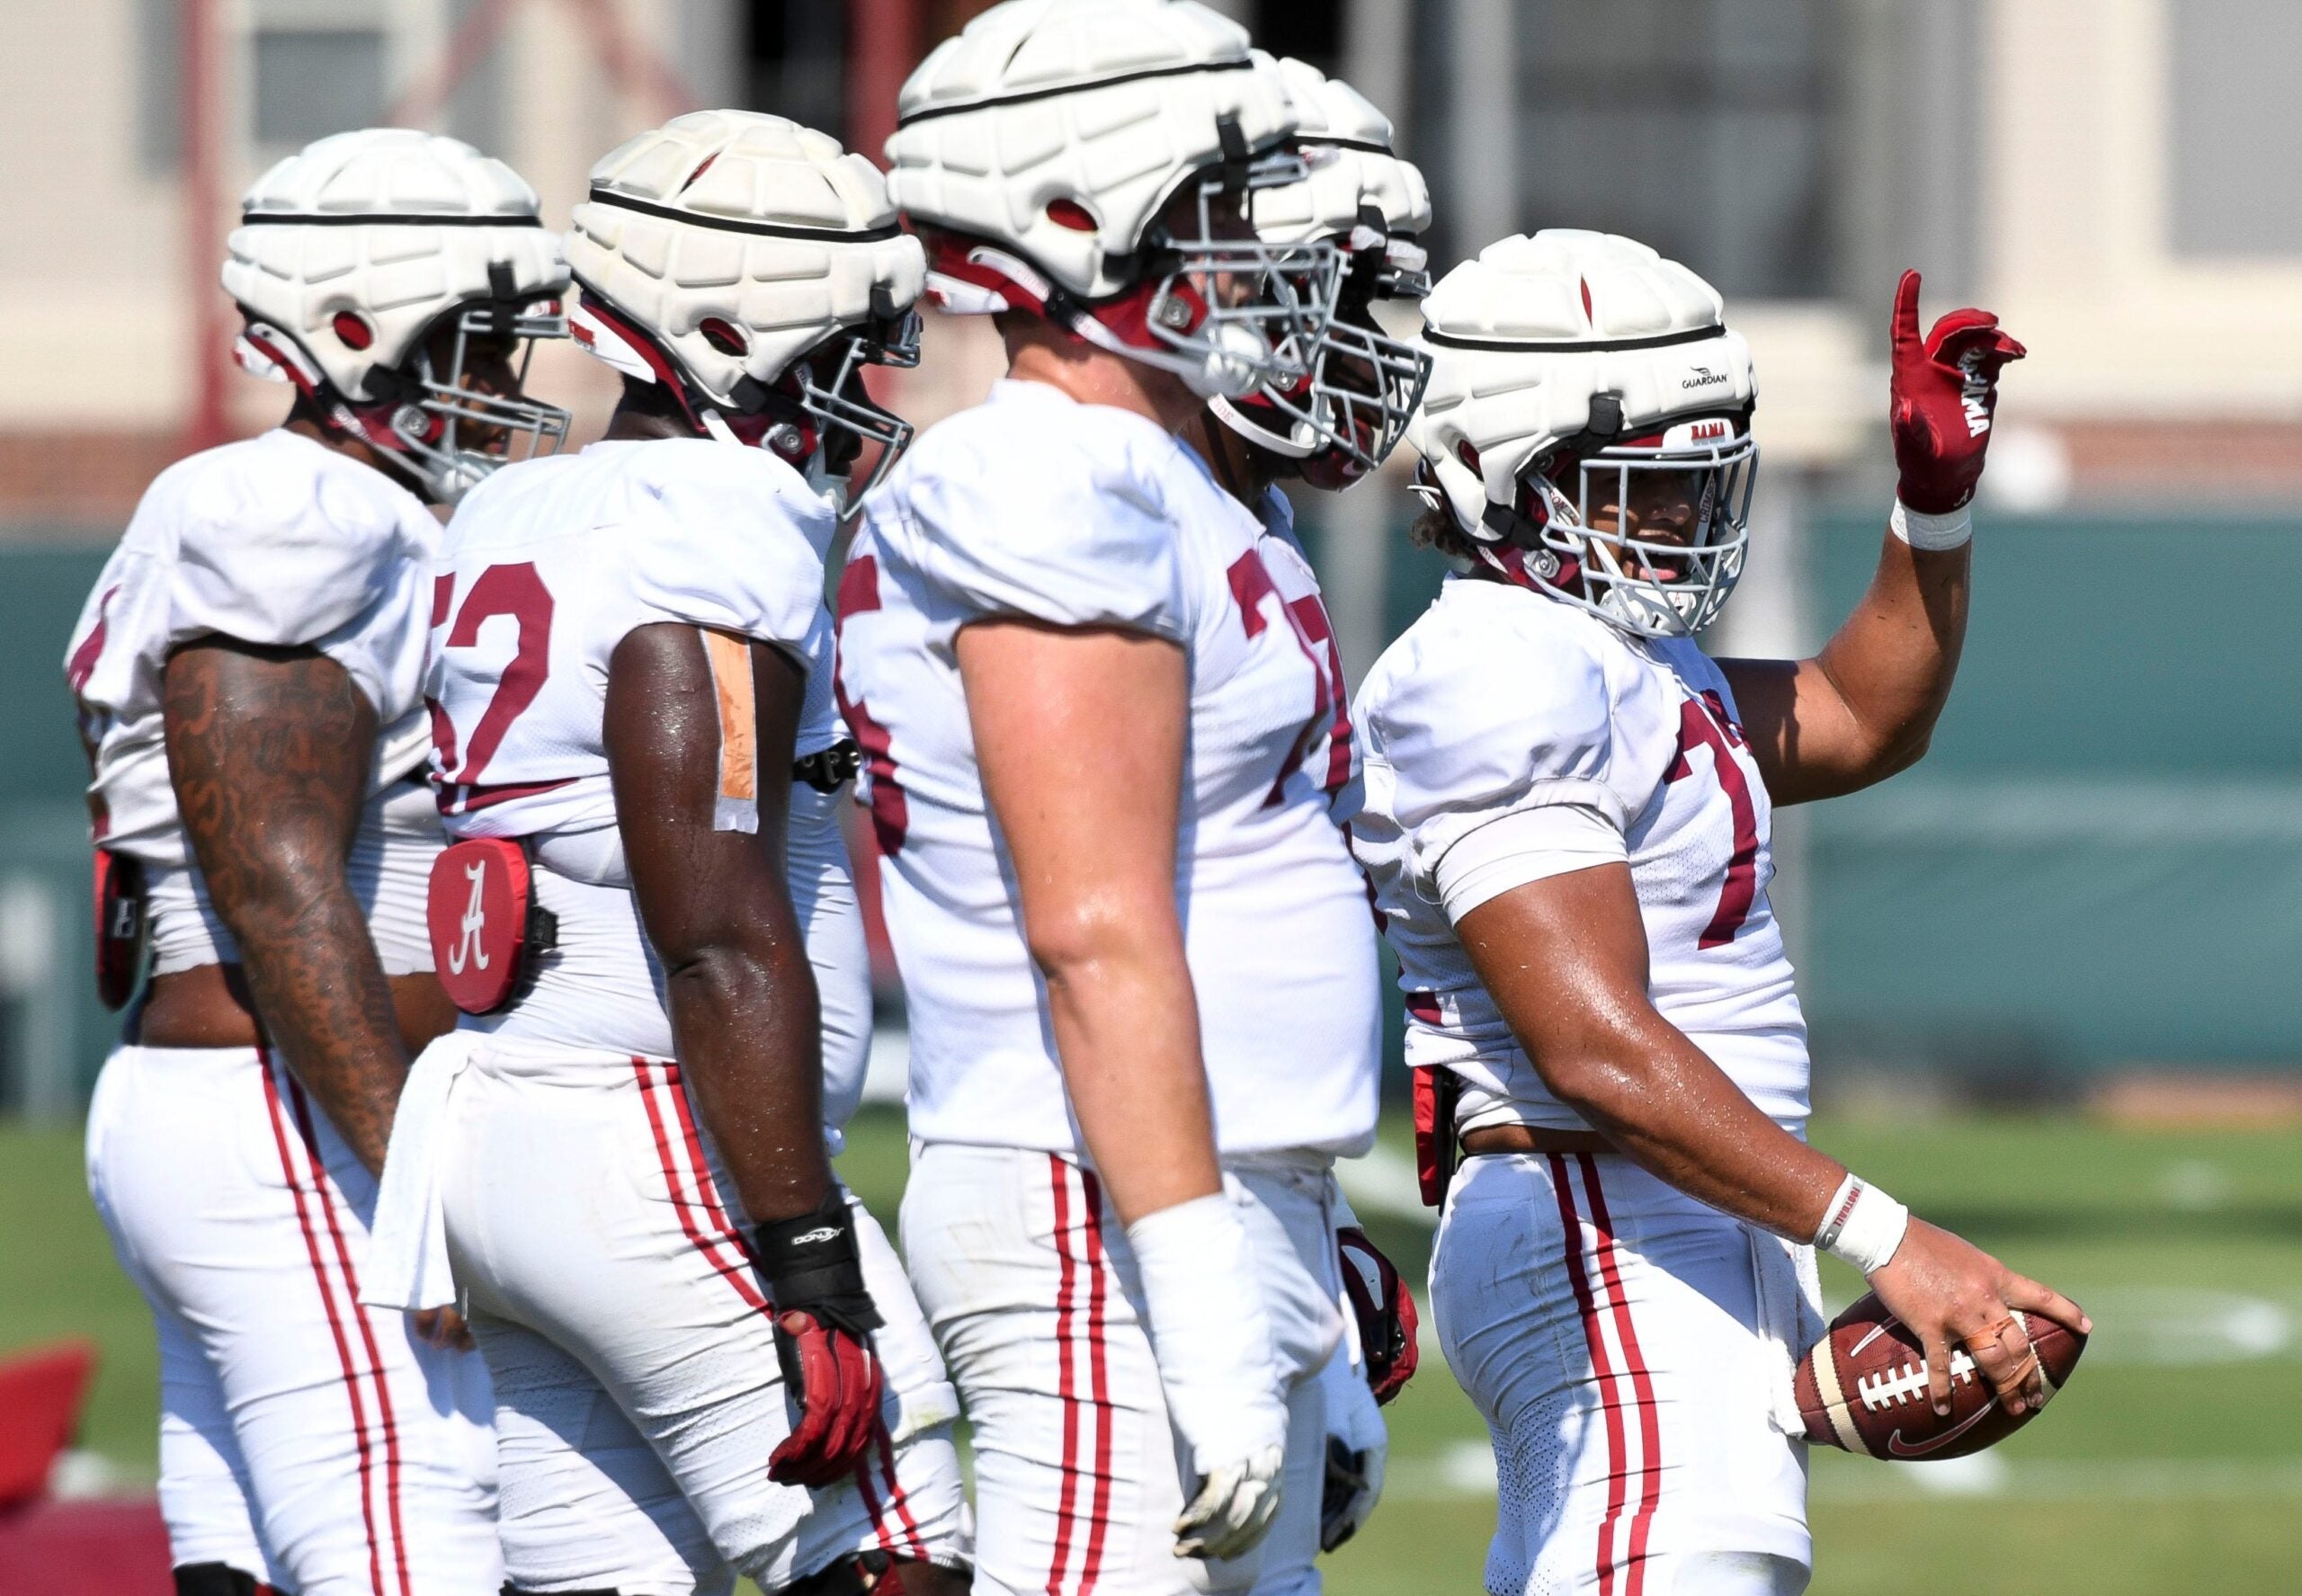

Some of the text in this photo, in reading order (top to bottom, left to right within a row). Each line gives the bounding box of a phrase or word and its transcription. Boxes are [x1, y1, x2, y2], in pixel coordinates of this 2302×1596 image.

[1682, 373, 1728, 389] GUARDIAN
[1691, 422, 1726, 441] BAMA
[450, 859, 489, 975] A
[1833, 1186, 1860, 1227] FOOTBALL
[791, 1227, 844, 1245] DONJOY
